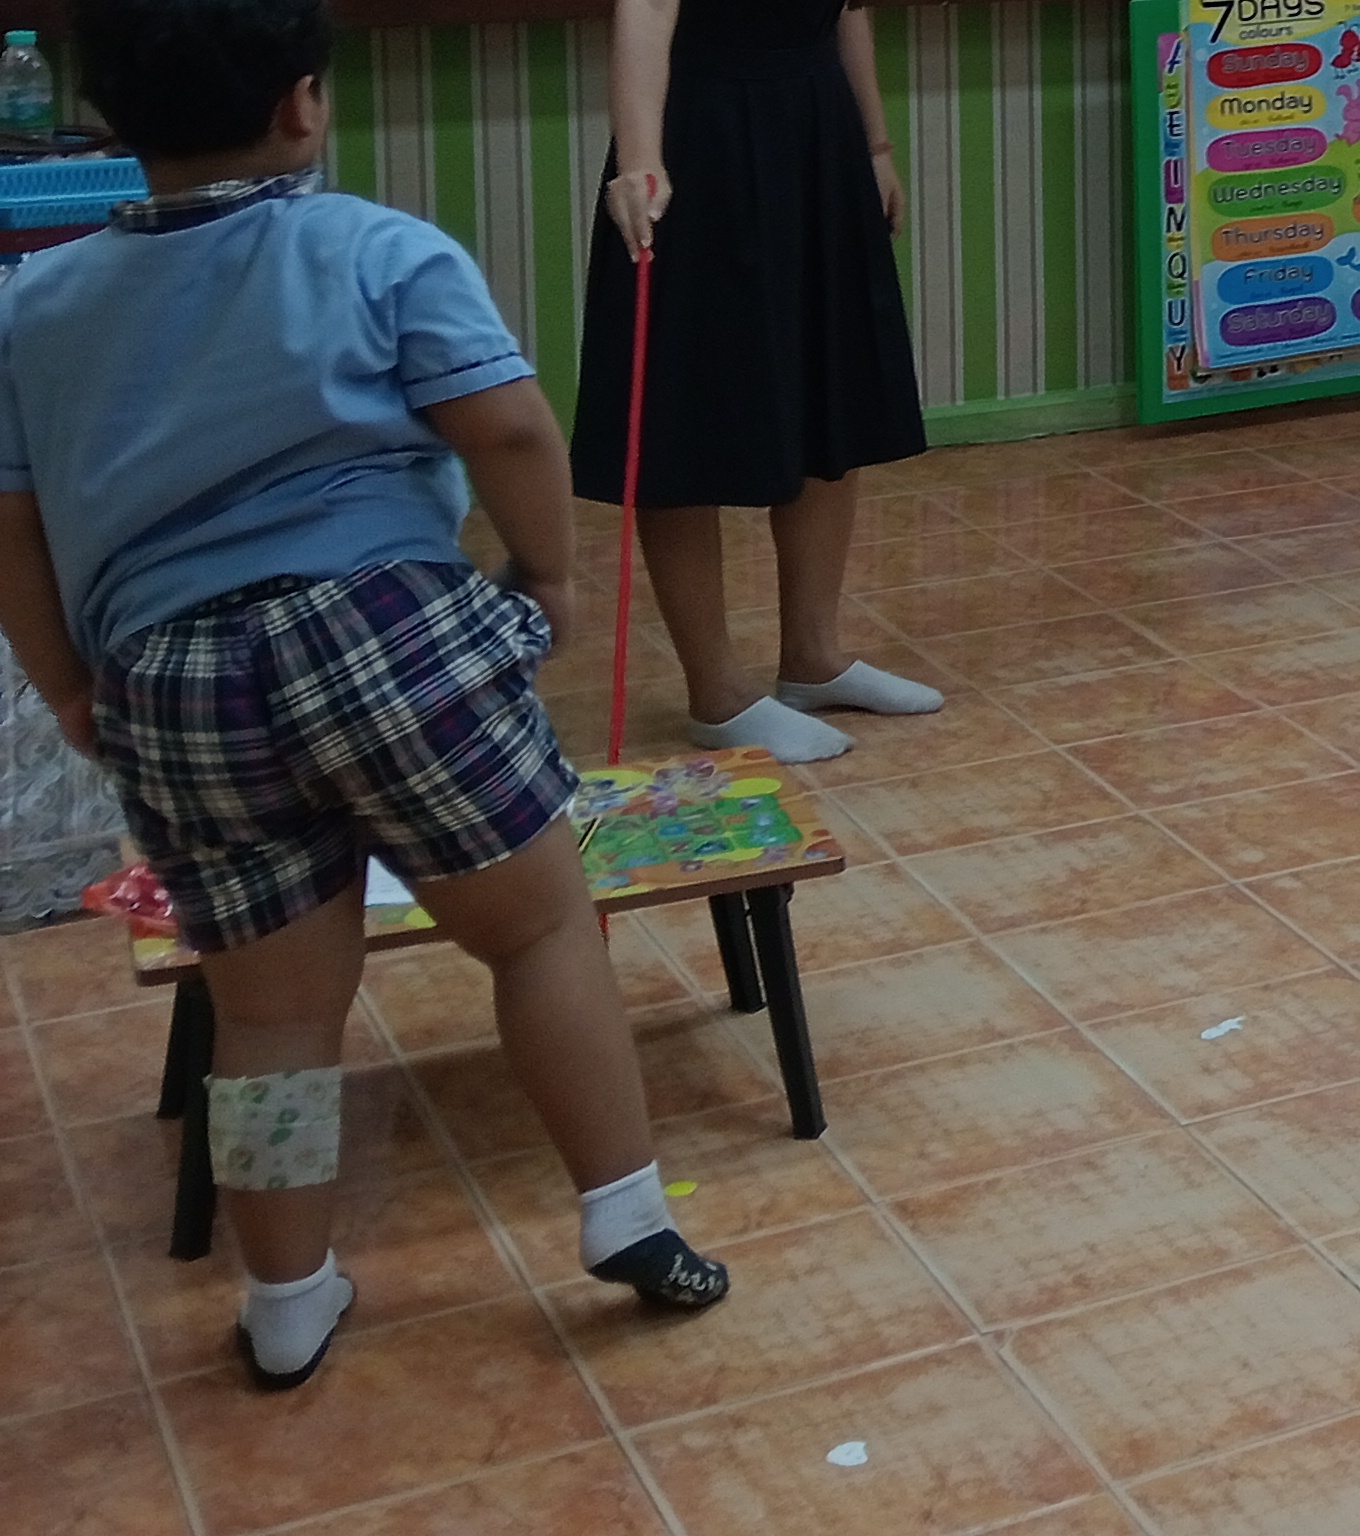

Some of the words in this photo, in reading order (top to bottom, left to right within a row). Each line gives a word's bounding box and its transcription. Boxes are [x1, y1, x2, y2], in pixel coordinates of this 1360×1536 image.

[1238, 24, 1294, 41] colours
[1221, 47, 1310, 73] Sunday
[1219, 91, 1314, 115] Monday
[1167, 110, 1184, 137] E
[1223, 135, 1318, 159] Tuesday
[1213, 172, 1343, 203] Wednesday
[1165, 206, 1186, 233] N
[1220, 221, 1326, 246] Thursday
[1167, 251, 1187, 280] Q
[1242, 262, 1316, 285] Friday
[1167, 300, 1187, 327] U
[1226, 301, 1334, 334] Saturday
[1168, 344, 1187, 373] Y
